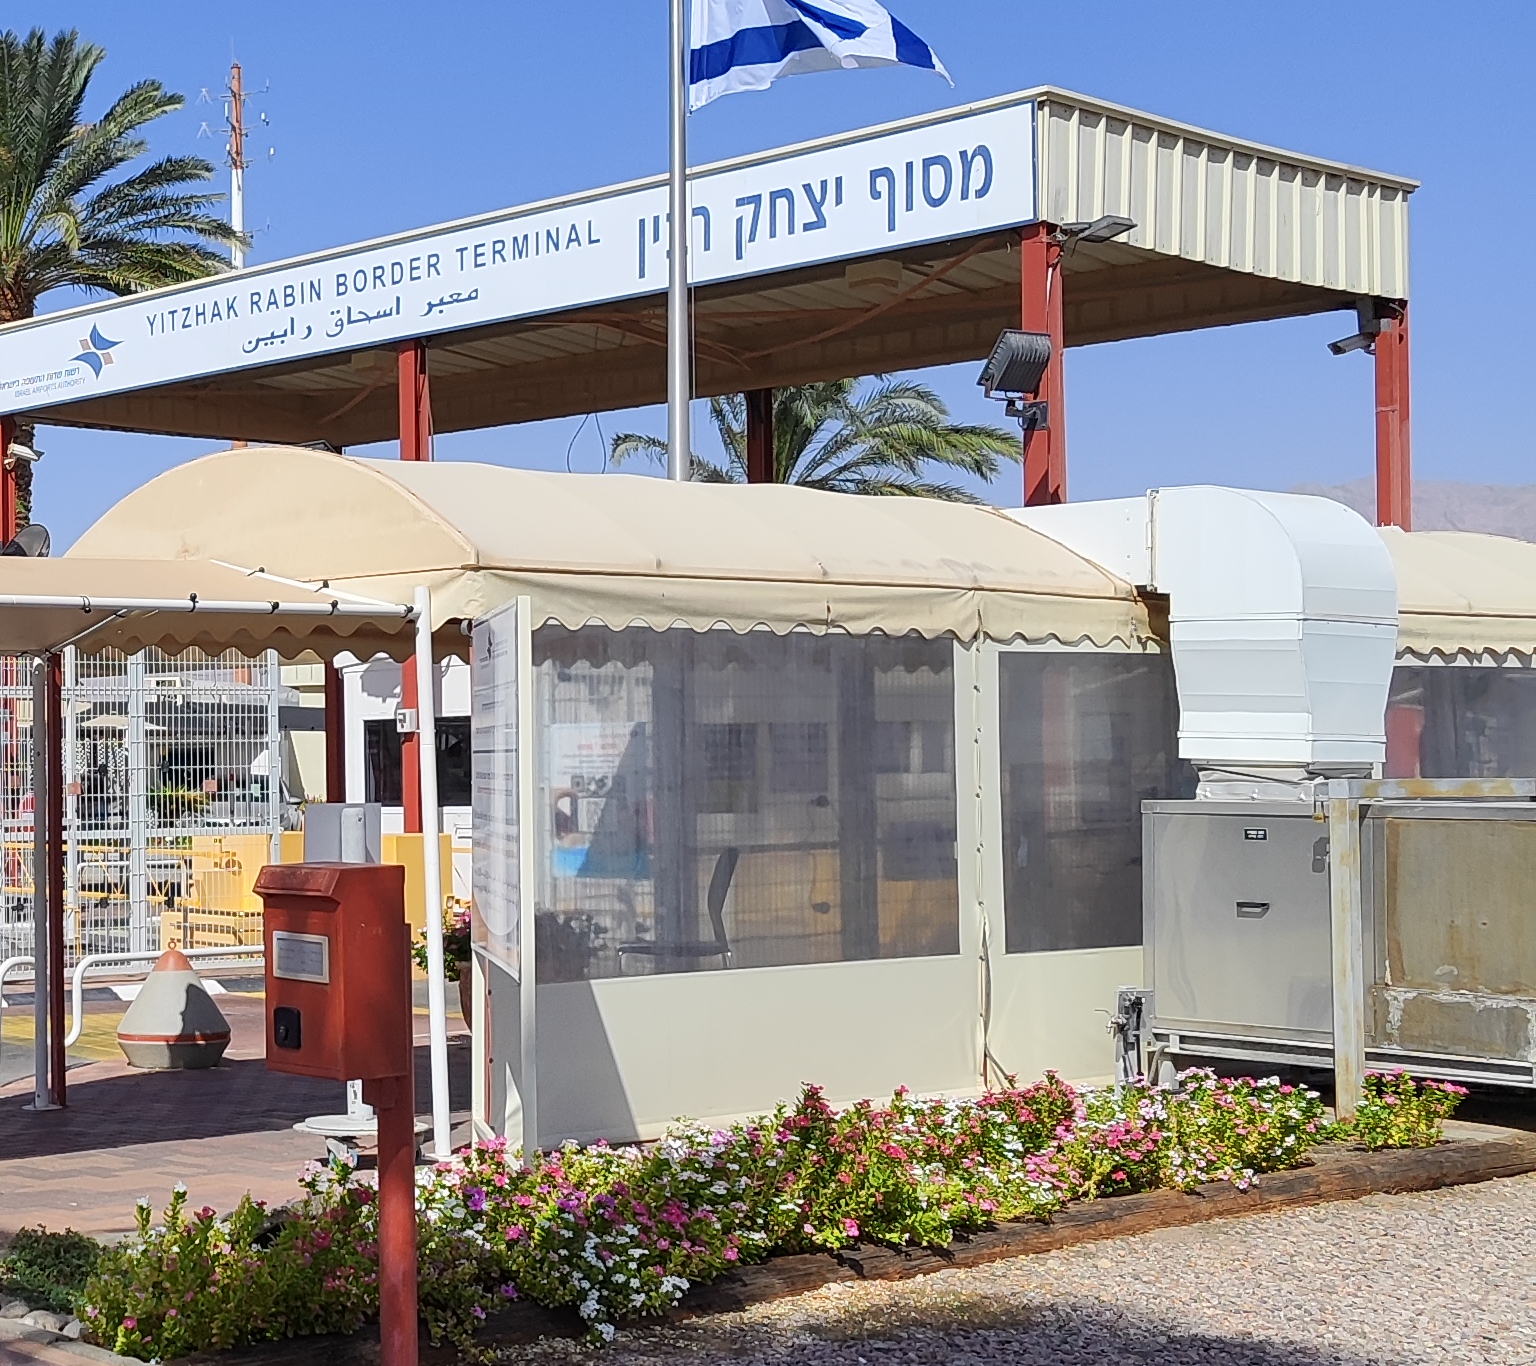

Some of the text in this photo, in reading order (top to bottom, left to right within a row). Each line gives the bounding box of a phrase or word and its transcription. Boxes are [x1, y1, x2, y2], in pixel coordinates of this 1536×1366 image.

[638, 144, 994, 279] מסוף יצחק רין
[146, 220, 601, 336] YITZHAK RABIN BORDER TERMINAL
[242, 287, 479, 354] معبر اسحاق رابين
